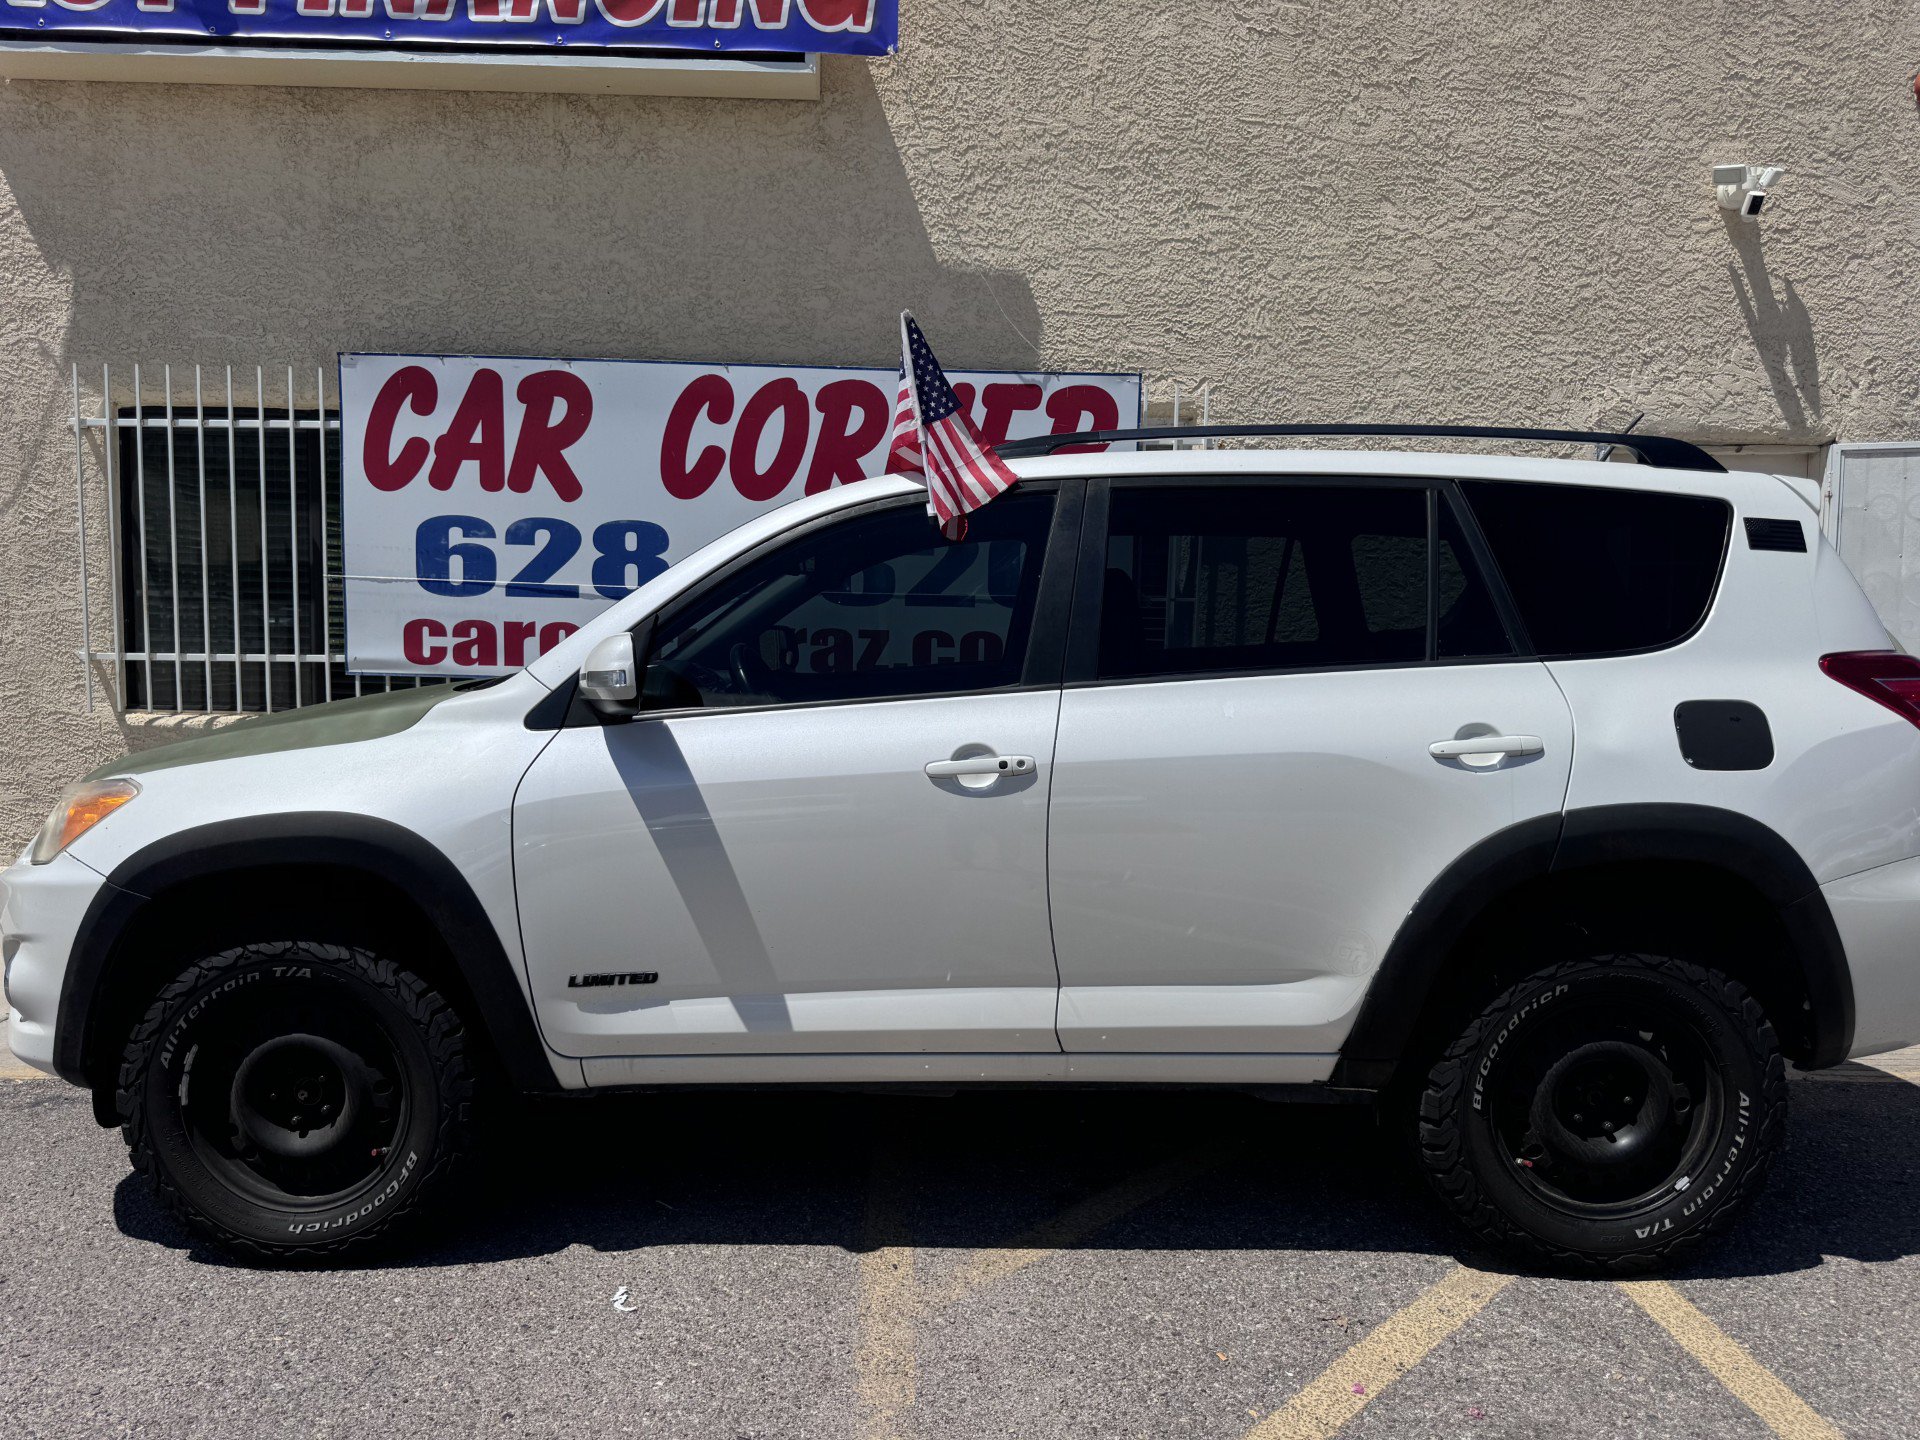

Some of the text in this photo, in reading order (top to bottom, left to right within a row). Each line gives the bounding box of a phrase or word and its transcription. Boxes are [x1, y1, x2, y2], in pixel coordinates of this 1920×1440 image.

[363, 365, 1119, 503] CAR CORER
[415, 515, 669, 601] 628
[160, 966, 313, 1069] All-Terrain T/A
[567, 971, 659, 988] LIMITED
[1473, 984, 1569, 1111] BFGoodrich
[288, 1151, 418, 1234] BFGoodrich
[1634, 1090, 1750, 1239] All-Terrain T/A
